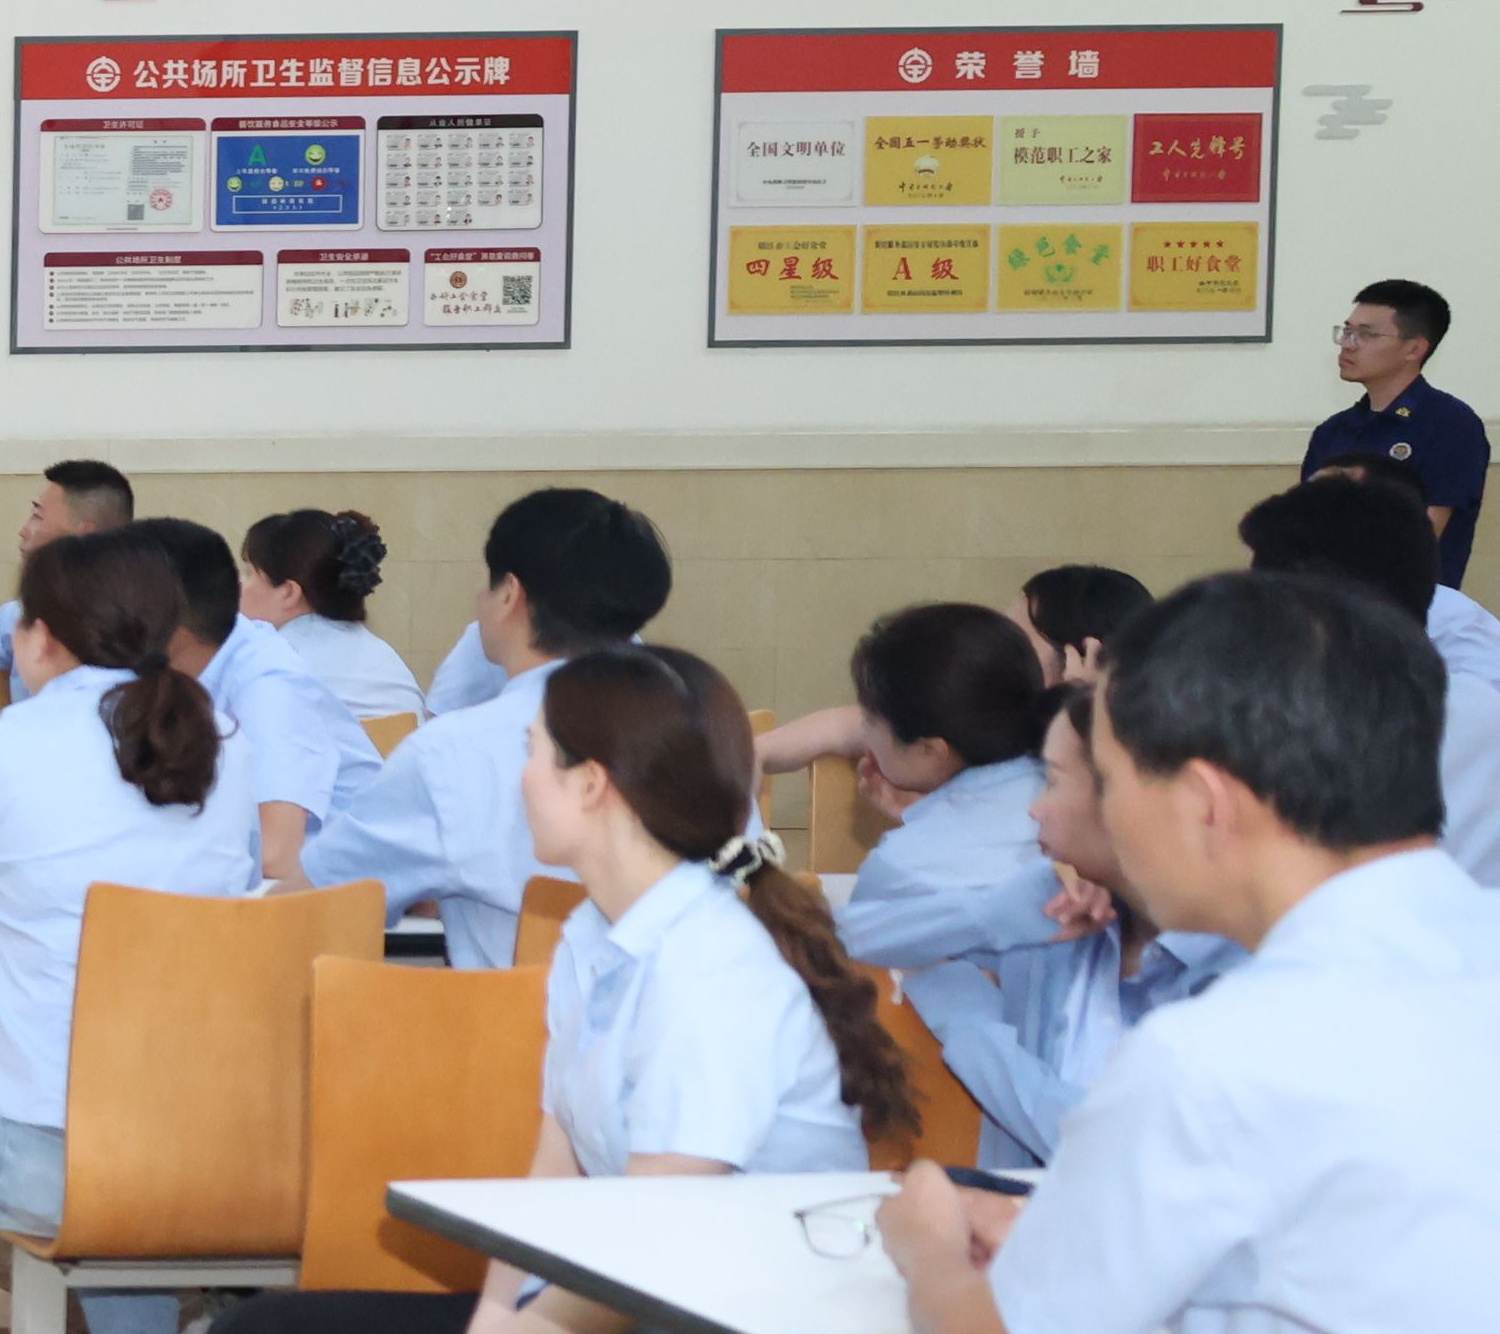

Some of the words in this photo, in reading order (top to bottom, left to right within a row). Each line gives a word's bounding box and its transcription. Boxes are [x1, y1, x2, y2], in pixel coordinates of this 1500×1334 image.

[133, 56, 511, 89] 公共场所卫生监督信息公示牌
[955, 48, 1100, 79] 荣誉墙
[248, 143, 267, 166] A
[747, 141, 846, 157] 全国文明单位
[1013, 145, 1113, 164] 模范职工之家
[1148, 134, 1245, 160] 工人先锋号
[745, 255, 840, 281] 四星级
[1146, 254, 1242, 273] 职工好食堂
